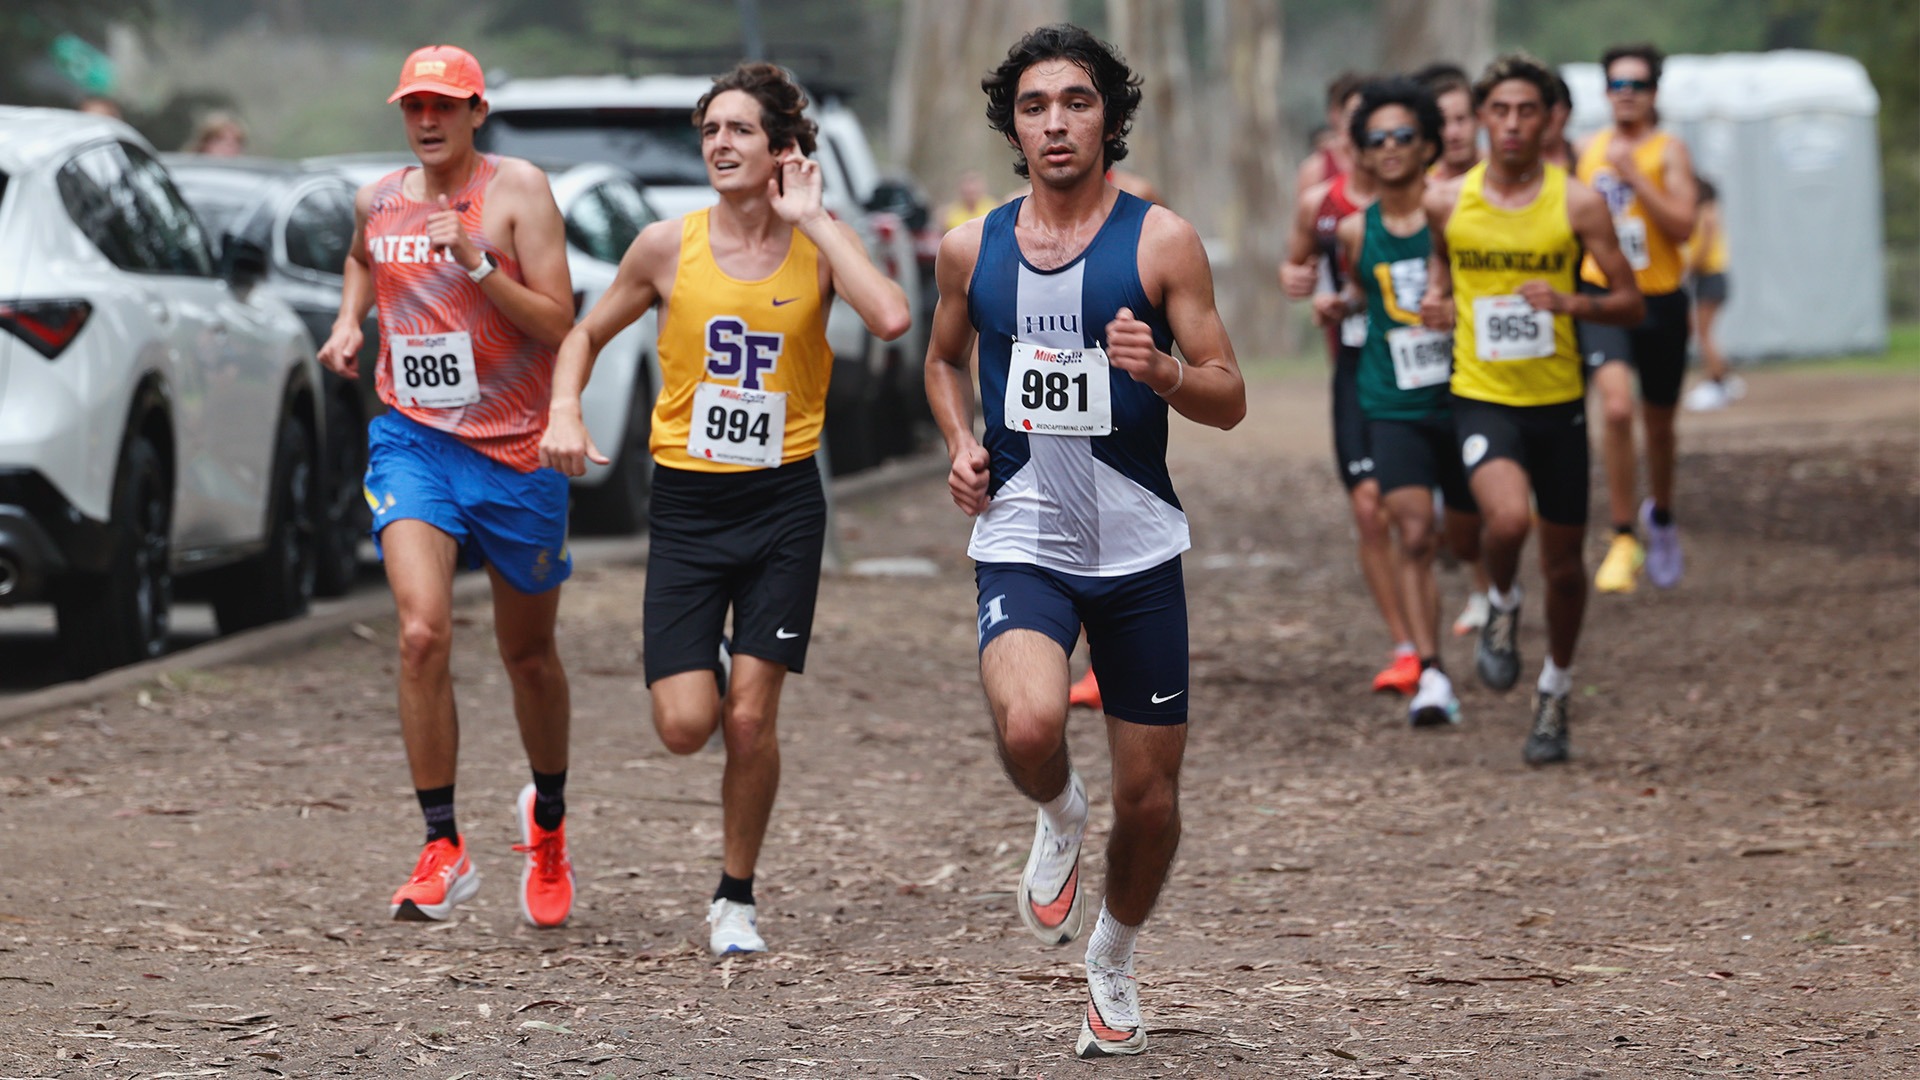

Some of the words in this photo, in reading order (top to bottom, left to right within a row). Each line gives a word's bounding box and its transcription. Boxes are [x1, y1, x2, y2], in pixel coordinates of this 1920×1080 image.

[1024, 314, 1079, 334] HIU
[1487, 314, 1539, 341] 965
[705, 315, 784, 390] SF
[1033, 349, 1083, 365] MileSplit
[403, 353, 461, 388] 886
[1021, 369, 1088, 412] 981
[706, 405, 770, 446] 994
[1035, 422, 1094, 432] REDCAPTIMING.COM
